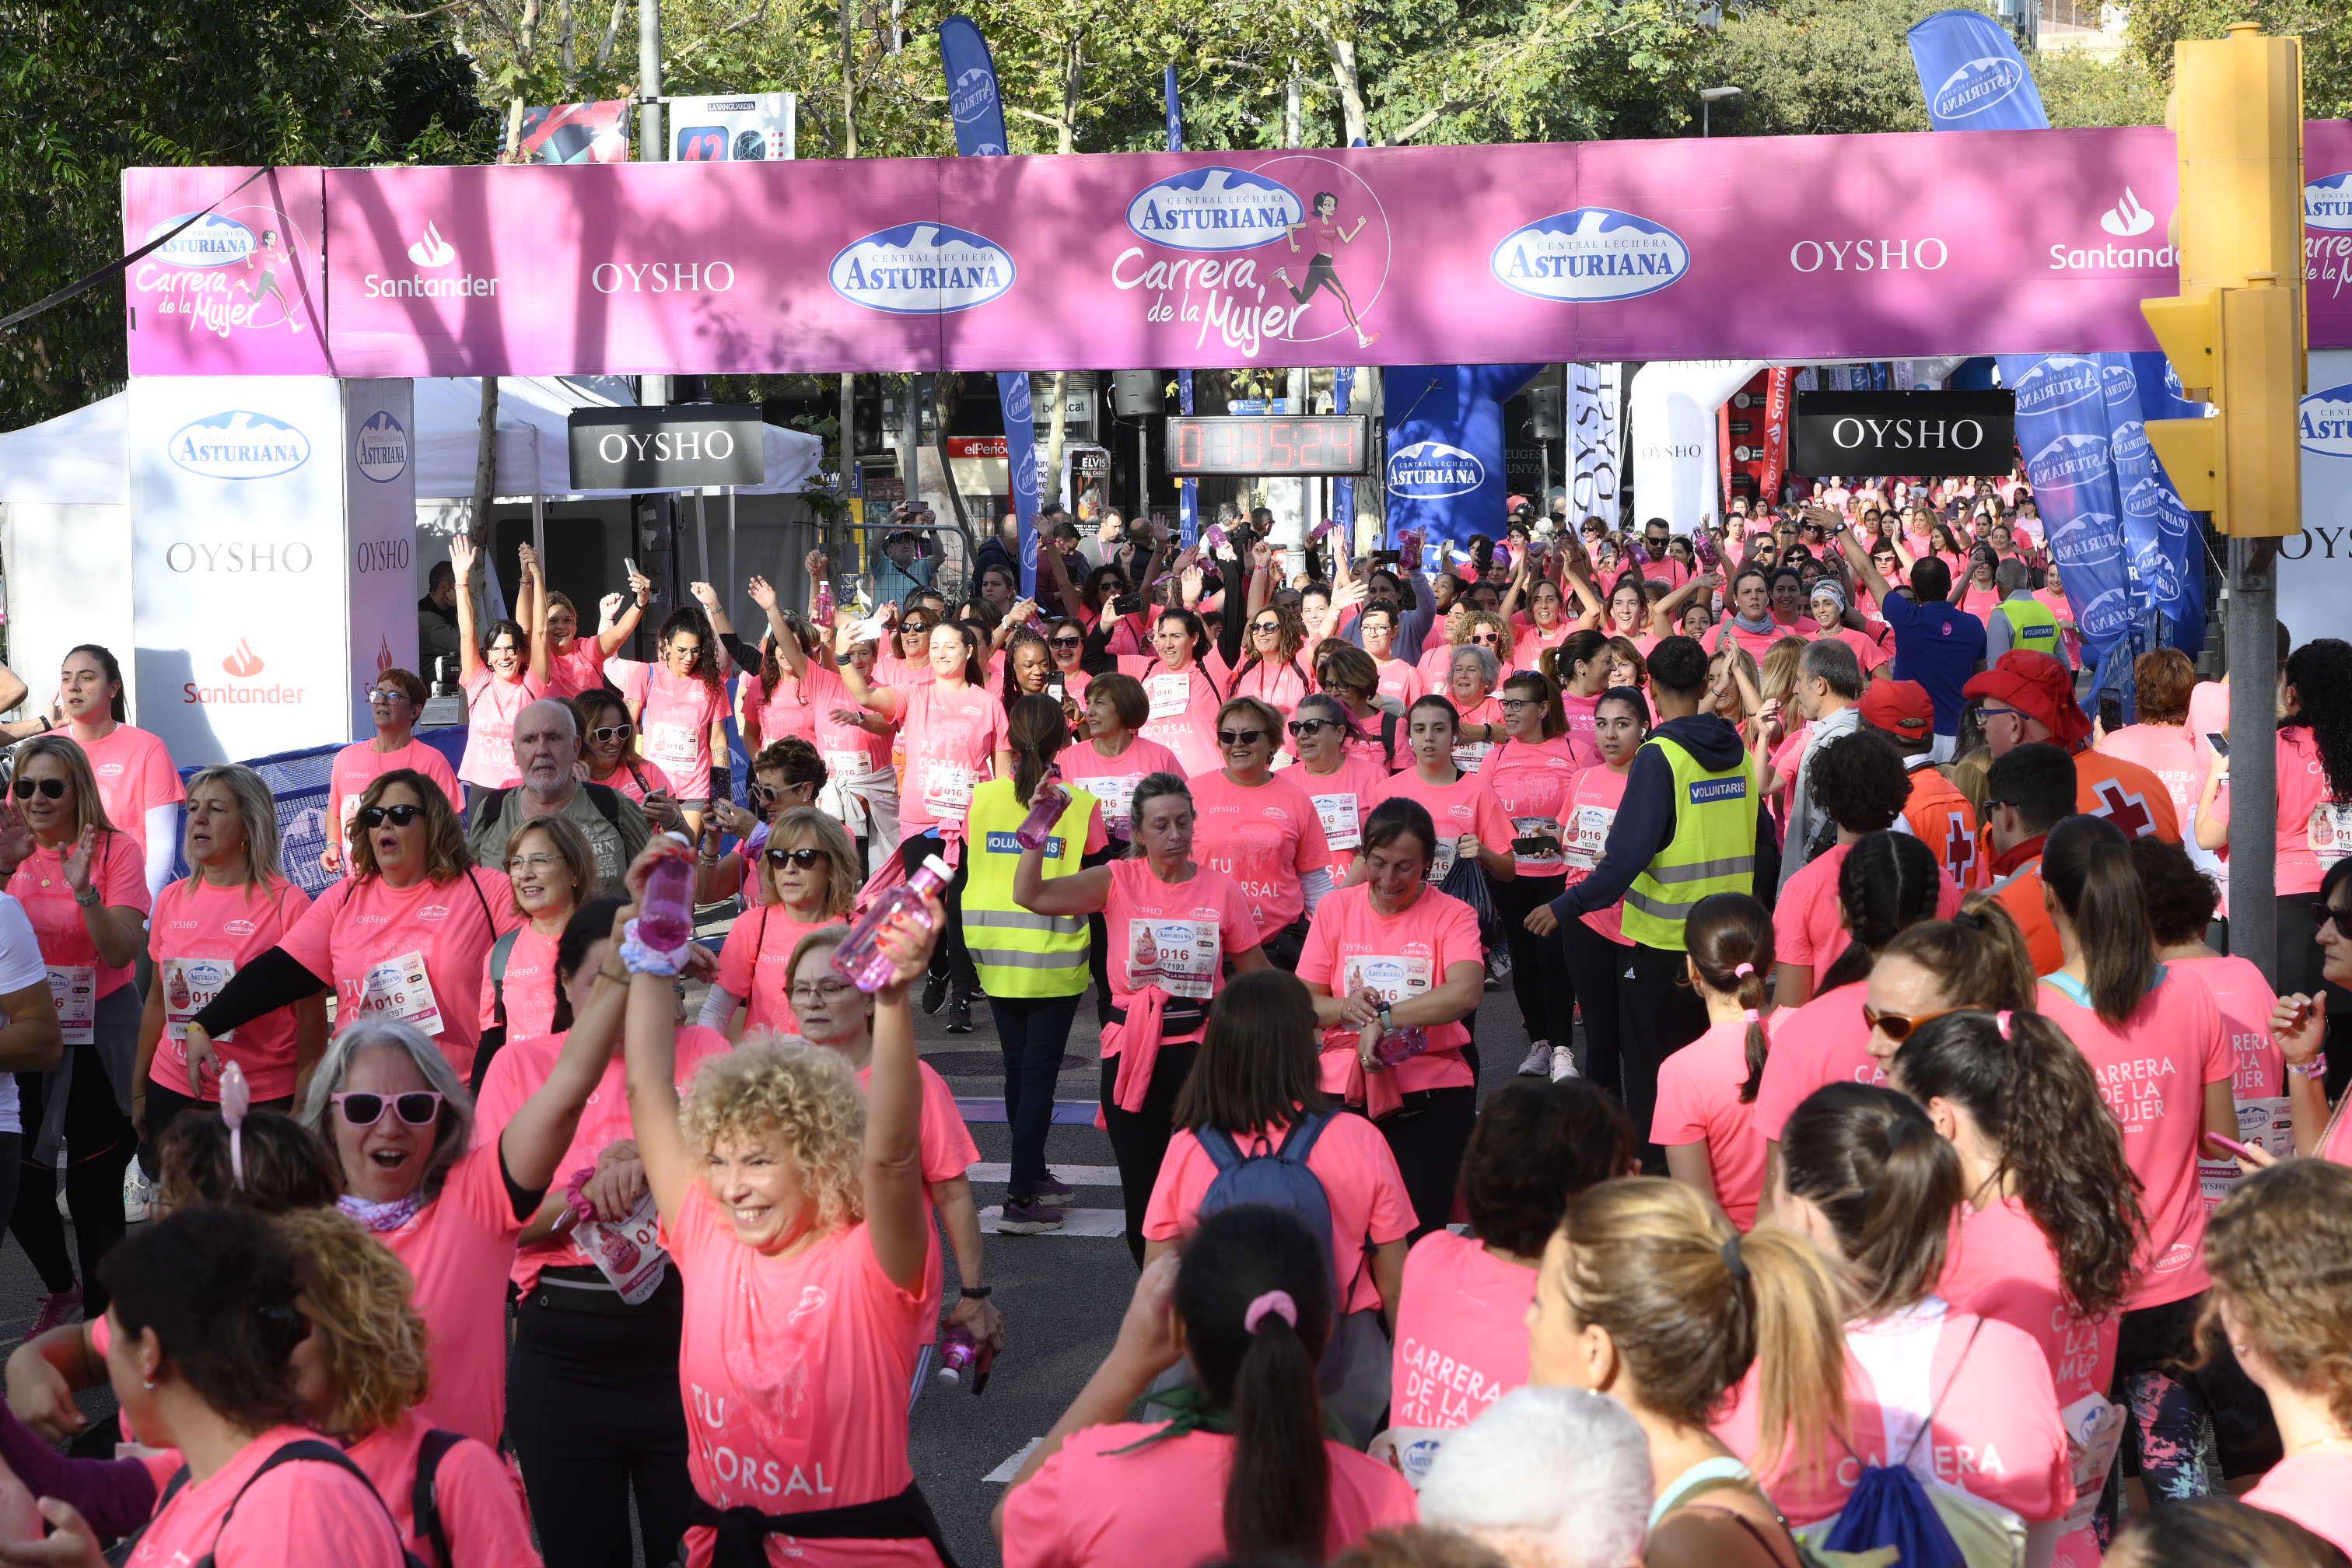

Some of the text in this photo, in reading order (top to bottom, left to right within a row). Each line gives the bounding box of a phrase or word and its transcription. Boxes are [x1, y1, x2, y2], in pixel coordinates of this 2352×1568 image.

[1167, 194, 1285, 205] CENTRAL LECHERA
[1140, 199, 1289, 229] ASTURIANA
[1537, 239, 1668, 250] CENTRAL LECHERA
[872, 253, 995, 263] CENTRAL LECHERA
[1507, 244, 1675, 278] ASTURIANA
[1790, 238, 1948, 272] OYSHO
[136, 263, 228, 292] Carrera
[593, 261, 735, 293] OYSHO
[844, 257, 1001, 290] ASTURIANA
[1111, 247, 1262, 291] Carrera
[364, 274, 499, 298] Santander
[158, 294, 191, 314] de la
[189, 289, 261, 338] Mujer
[1147, 292, 1199, 323] de la
[1196, 285, 1311, 358] Mujer
[1832, 418, 1983, 449] OYSHO
[180, 436, 301, 462] ASTURIANA
[359, 437, 404, 465] ASTURIANA
[599, 430, 734, 463] OYSHO
[1643, 444, 1701, 459] OYSHO
[1082, 457, 1107, 467] ELVIS
[1390, 467, 1477, 486] ASTURIANA
[166, 542, 313, 573] OYSHO
[358, 538, 409, 573] OYSHO
[184, 682, 305, 704] Santander
[1144, 722, 1194, 737] DORSAL
[944, 788, 963, 797] 016
[1692, 782, 1745, 799] VOLUNTARIS
[1103, 799, 1118, 807] 16
[1209, 805, 1241, 814] OYSHO
[1321, 814, 1335, 824] 16
[988, 836, 1059, 853] VOLUNIS
[1580, 829, 1601, 841] 016
[1210, 858, 1232, 874] TU
[1434, 861, 1449, 870] 16
[169, 921, 198, 929] OYSHO
[1160, 948, 1189, 961] 016
[1163, 962, 1185, 971] 17193
[374, 992, 405, 1010] 016
[1379, 989, 1398, 1001] 16
[2241, 1057, 2260, 1071] LA
[2133, 1080, 2161, 1103] LA
[2123, 1124, 2144, 1133] 2023
[1402, 1337, 1501, 1402] CARRERA
[691, 1382, 726, 1430] TU
[1405, 1374, 1434, 1405] DE
[1439, 1384, 1470, 1423] LA
